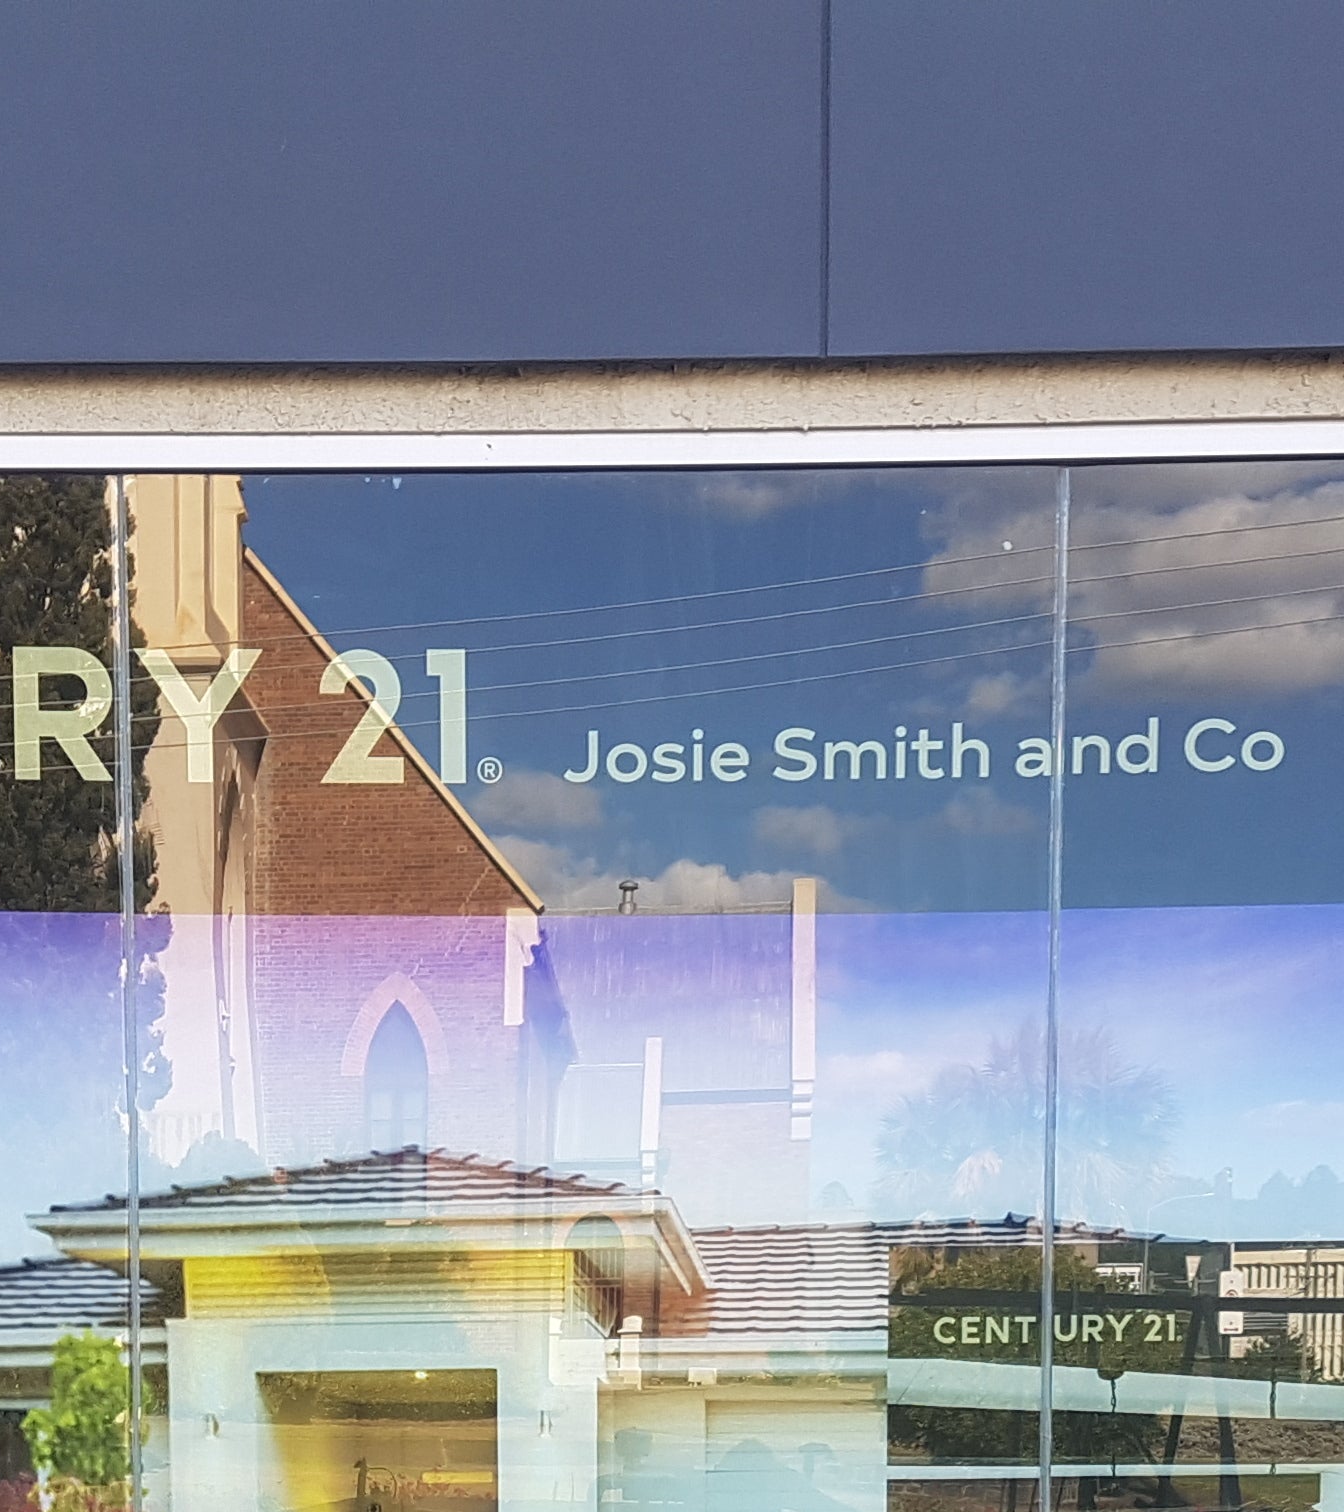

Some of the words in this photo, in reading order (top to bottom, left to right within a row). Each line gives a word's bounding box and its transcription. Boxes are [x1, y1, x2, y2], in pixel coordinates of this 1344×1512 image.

[564, 728, 749, 784] Josie
[774, 722, 991, 783] Smith
[1013, 715, 1160, 781] and
[1183, 717, 1286, 774] Co
[932, 1312, 1134, 1346] CENTURY
